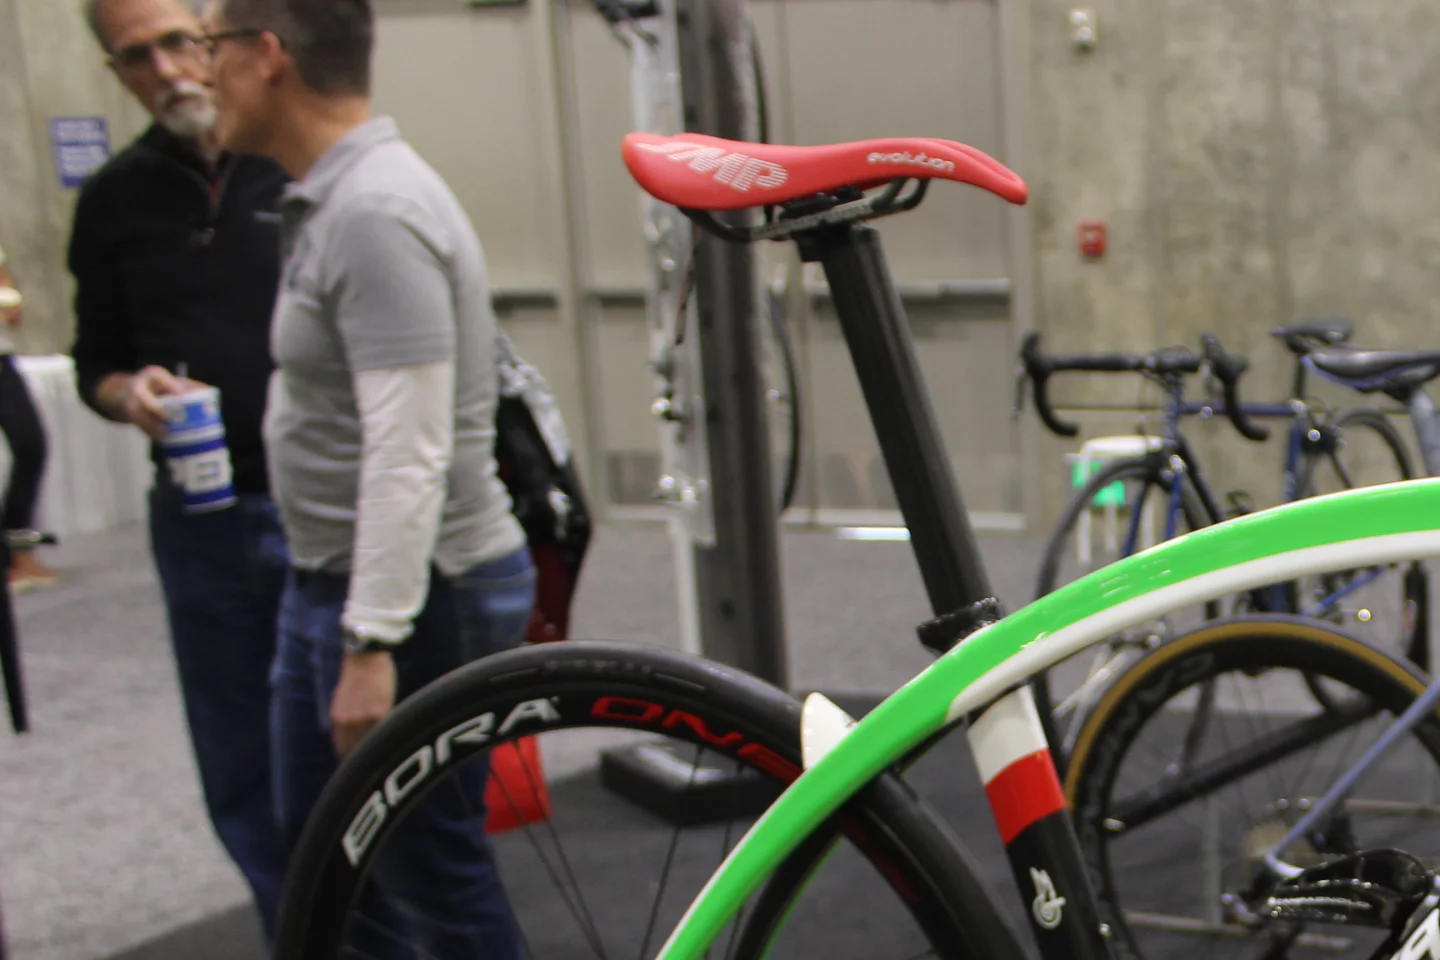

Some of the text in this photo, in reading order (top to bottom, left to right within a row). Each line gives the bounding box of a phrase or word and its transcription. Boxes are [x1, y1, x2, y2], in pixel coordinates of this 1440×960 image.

[866, 151, 956, 173] evolution
[342, 696, 804, 867] BORA ONE
